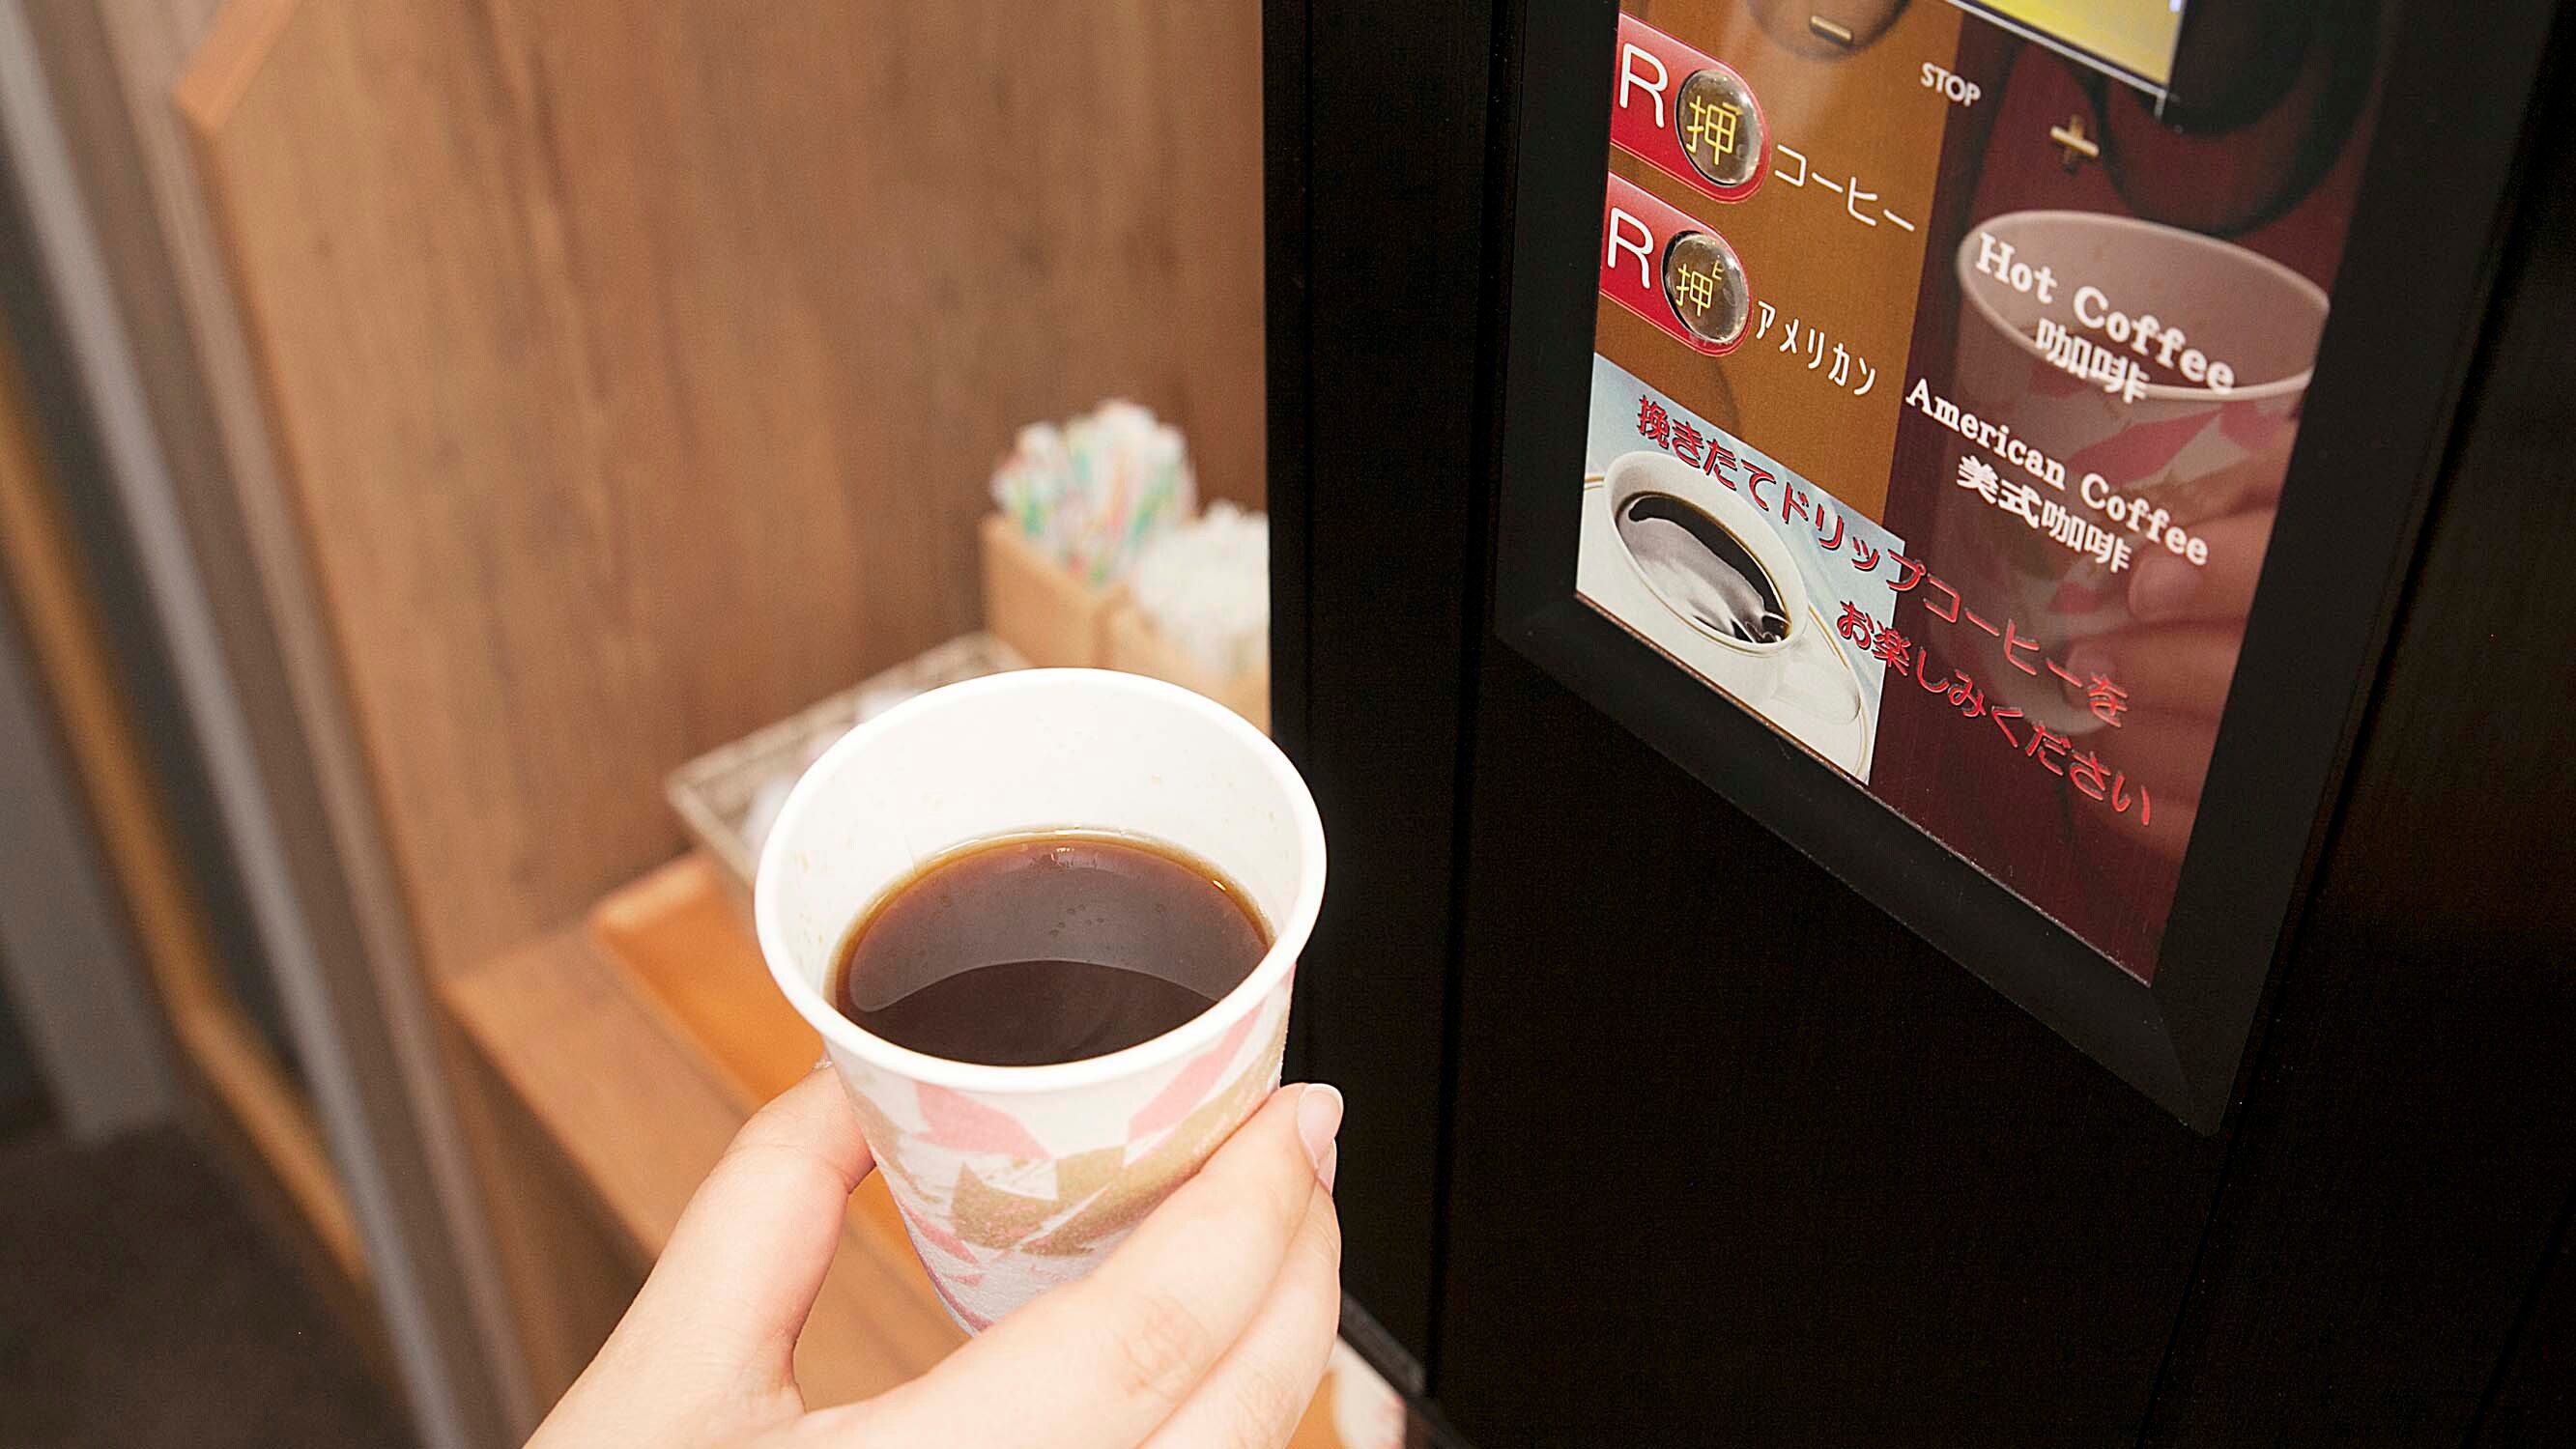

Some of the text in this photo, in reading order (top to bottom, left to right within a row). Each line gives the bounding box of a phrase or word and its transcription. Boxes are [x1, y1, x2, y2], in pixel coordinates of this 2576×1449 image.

[1619, 43, 1669, 128] R
[1921, 62, 1982, 107] STOP
[1775, 144, 1915, 232] コーヒー
[1607, 207, 1654, 289] R
[1756, 300, 1876, 396] アメリカン
[1976, 233, 2235, 394] Hot Coffee
[2036, 318, 2151, 403] 咖啡
[1905, 378, 2210, 566] American Coffee
[1957, 455, 2132, 573] 美式咖啡
[1637, 394, 2128, 728] 挽きたてドリップコーヒーを
[1836, 600, 2151, 826] お楽しみください
